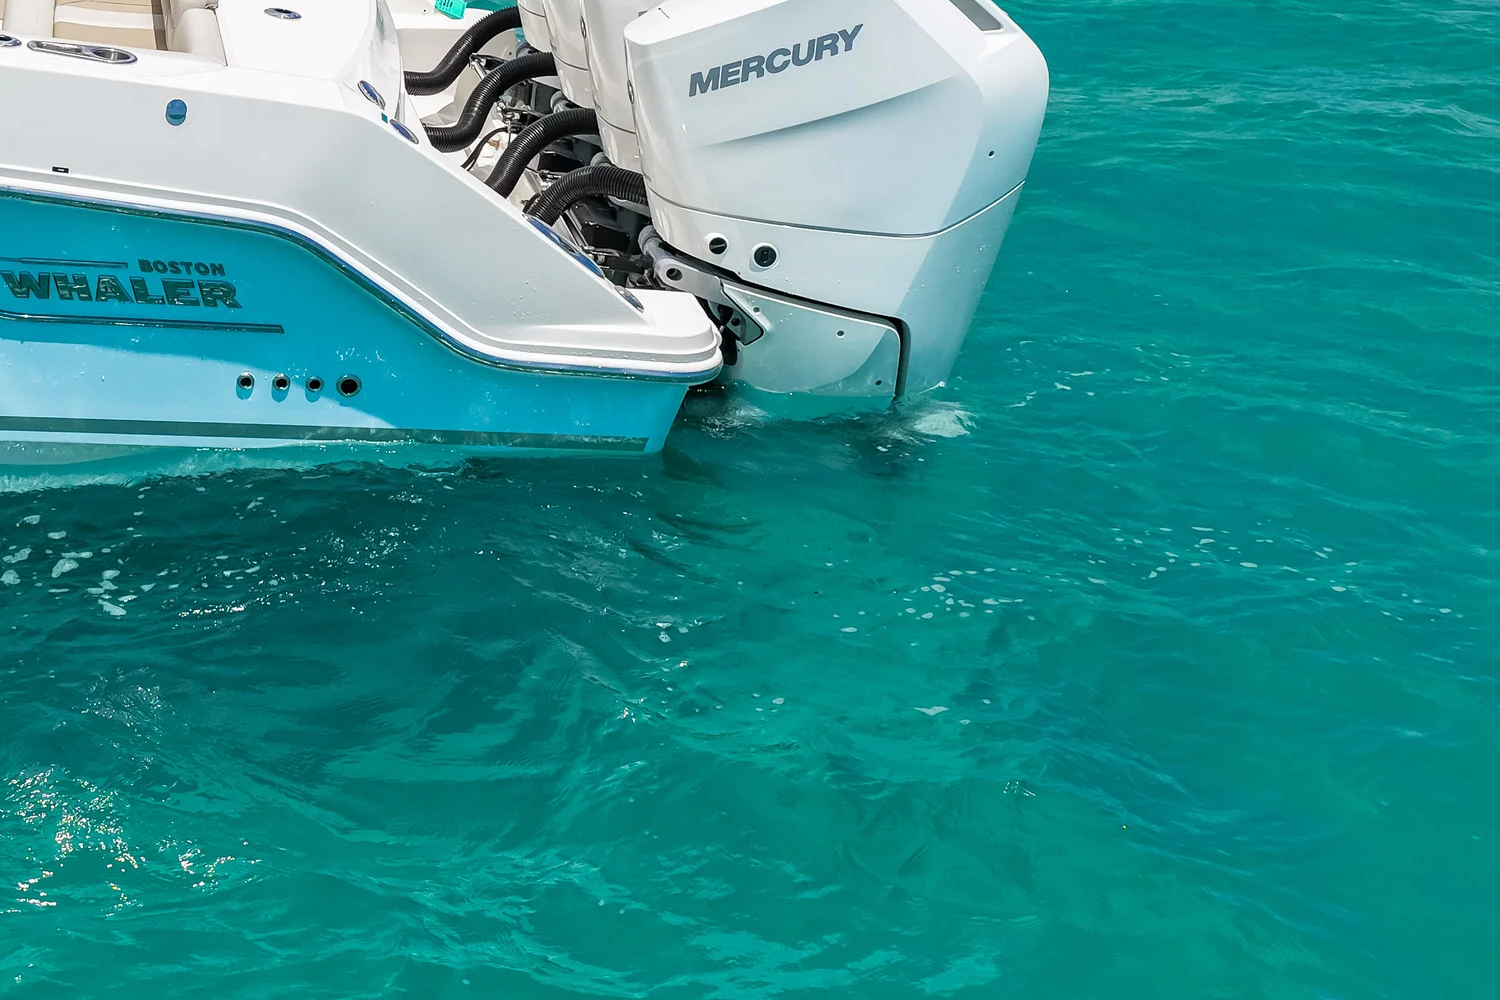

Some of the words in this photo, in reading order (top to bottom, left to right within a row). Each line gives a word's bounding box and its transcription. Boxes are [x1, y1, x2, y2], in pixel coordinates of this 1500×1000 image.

[689, 24, 864, 97] MERCURY
[138, 259, 226, 277] BOSTON
[0, 270, 243, 309] WHALER
